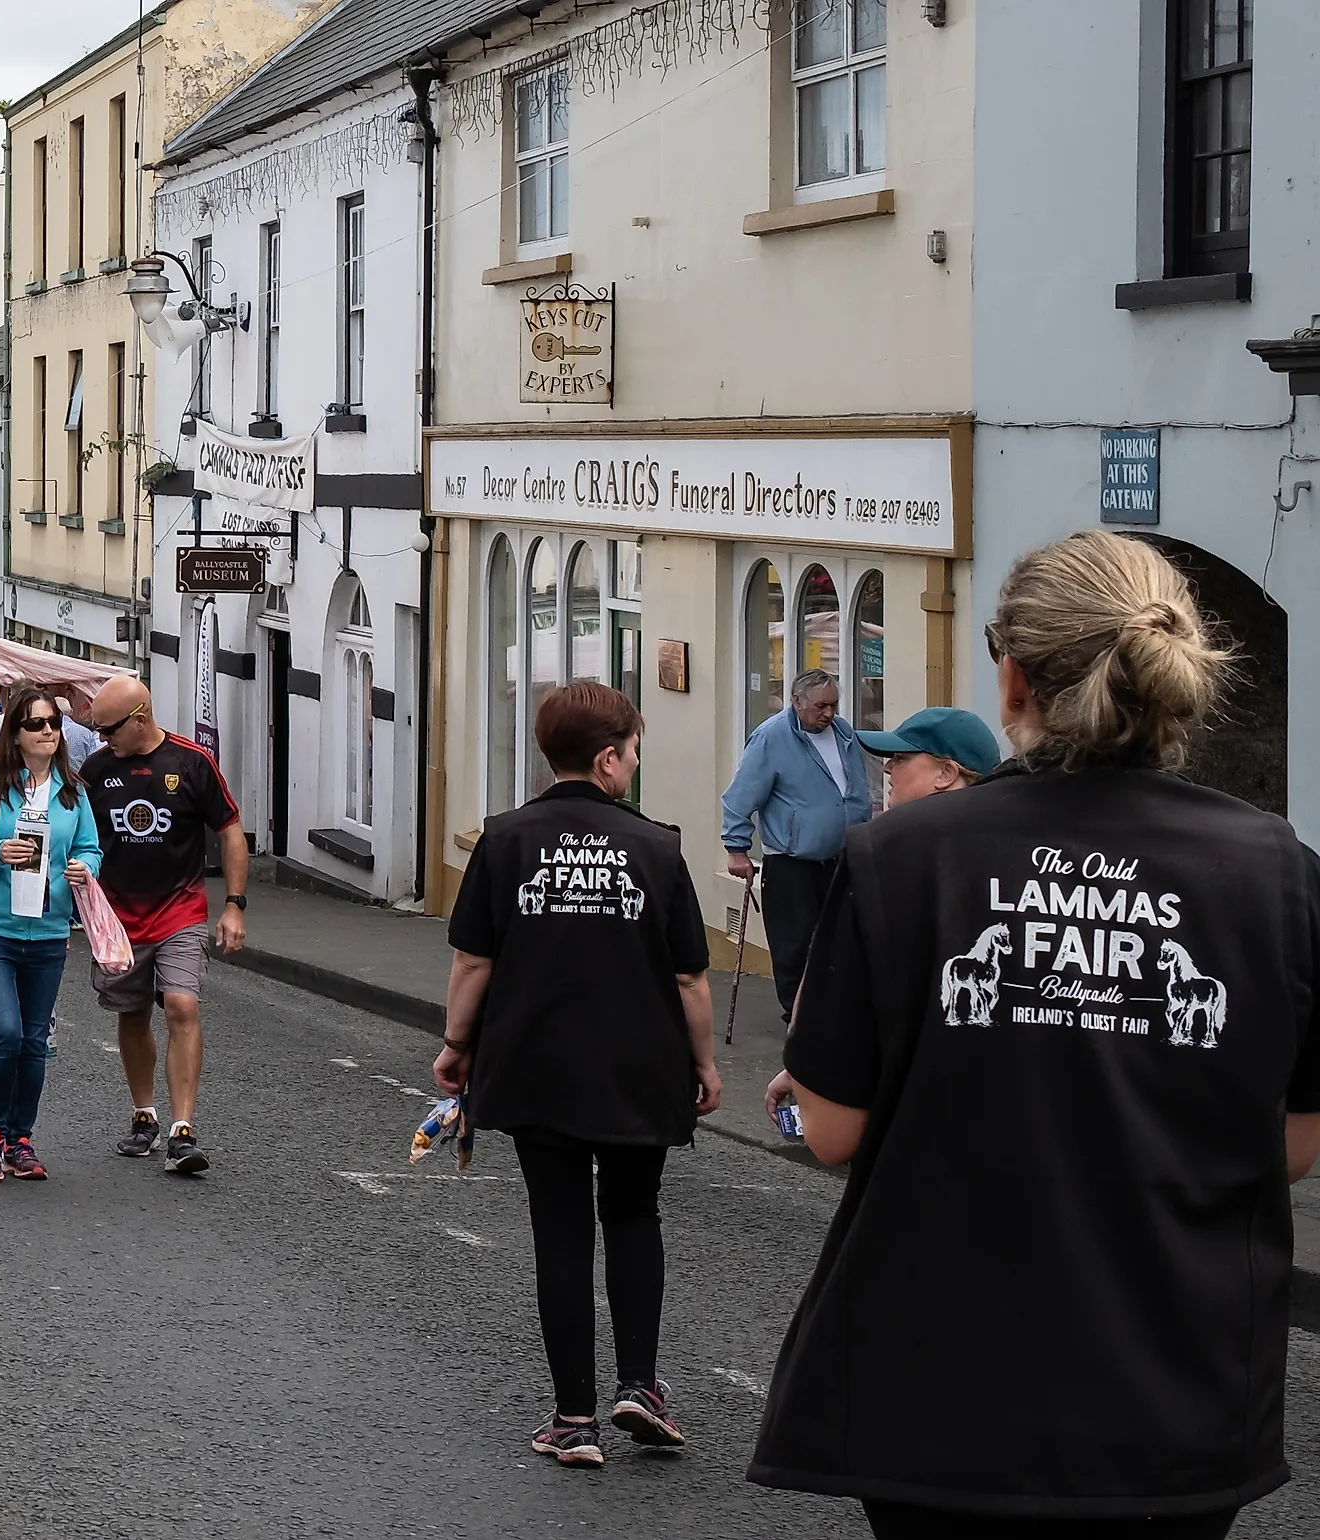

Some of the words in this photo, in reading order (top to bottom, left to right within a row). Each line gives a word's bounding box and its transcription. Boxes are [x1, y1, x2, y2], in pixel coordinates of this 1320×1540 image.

[525, 307, 568, 332] KEYS
[574, 308, 607, 333] CUT
[559, 363, 576, 376] BY
[525, 369, 607, 395] EXPERTS
[1101, 438, 1112, 459] NO
[1113, 438, 1157, 459] PARKING
[241, 450, 267, 487] FAIR
[1106, 463, 1120, 484] AT
[1122, 463, 1149, 484] THIS
[483, 465, 518, 498] Decor
[523, 465, 566, 503] Centre
[573, 454, 660, 511] CRAIG'S
[670, 470, 735, 514] Funeral
[743, 471, 837, 519] Directors
[881, 499, 901, 523] 207
[905, 499, 941, 526] 62403
[1102, 489, 1155, 511] GATEWAY
[221, 511, 242, 533] LOST
[192, 569, 250, 581] MUSEUM
[195, 561, 248, 569] BALLYCASTLE
[104, 777, 125, 789] GAA
[559, 832, 579, 847] The
[582, 833, 609, 847] Ould
[540, 847, 628, 867] LAMMAS
[1031, 846, 1075, 875] The
[1082, 852, 1139, 881] Ould
[555, 867, 612, 890] FAIR
[561, 889, 604, 904] Ballycastle
[989, 877, 1182, 928] LAMMAS
[550, 904, 578, 914] IRELAND'S
[580, 904, 600, 914] OLDEST
[602, 906, 616, 915] FAIR
[1024, 921, 1145, 980] FAIR
[1038, 974, 1125, 1007] Ballycastle
[1012, 1006, 1074, 1028] IRELAND'S
[1080, 1012, 1117, 1032] OLDEST
[1121, 1016, 1150, 1035] FAIR
